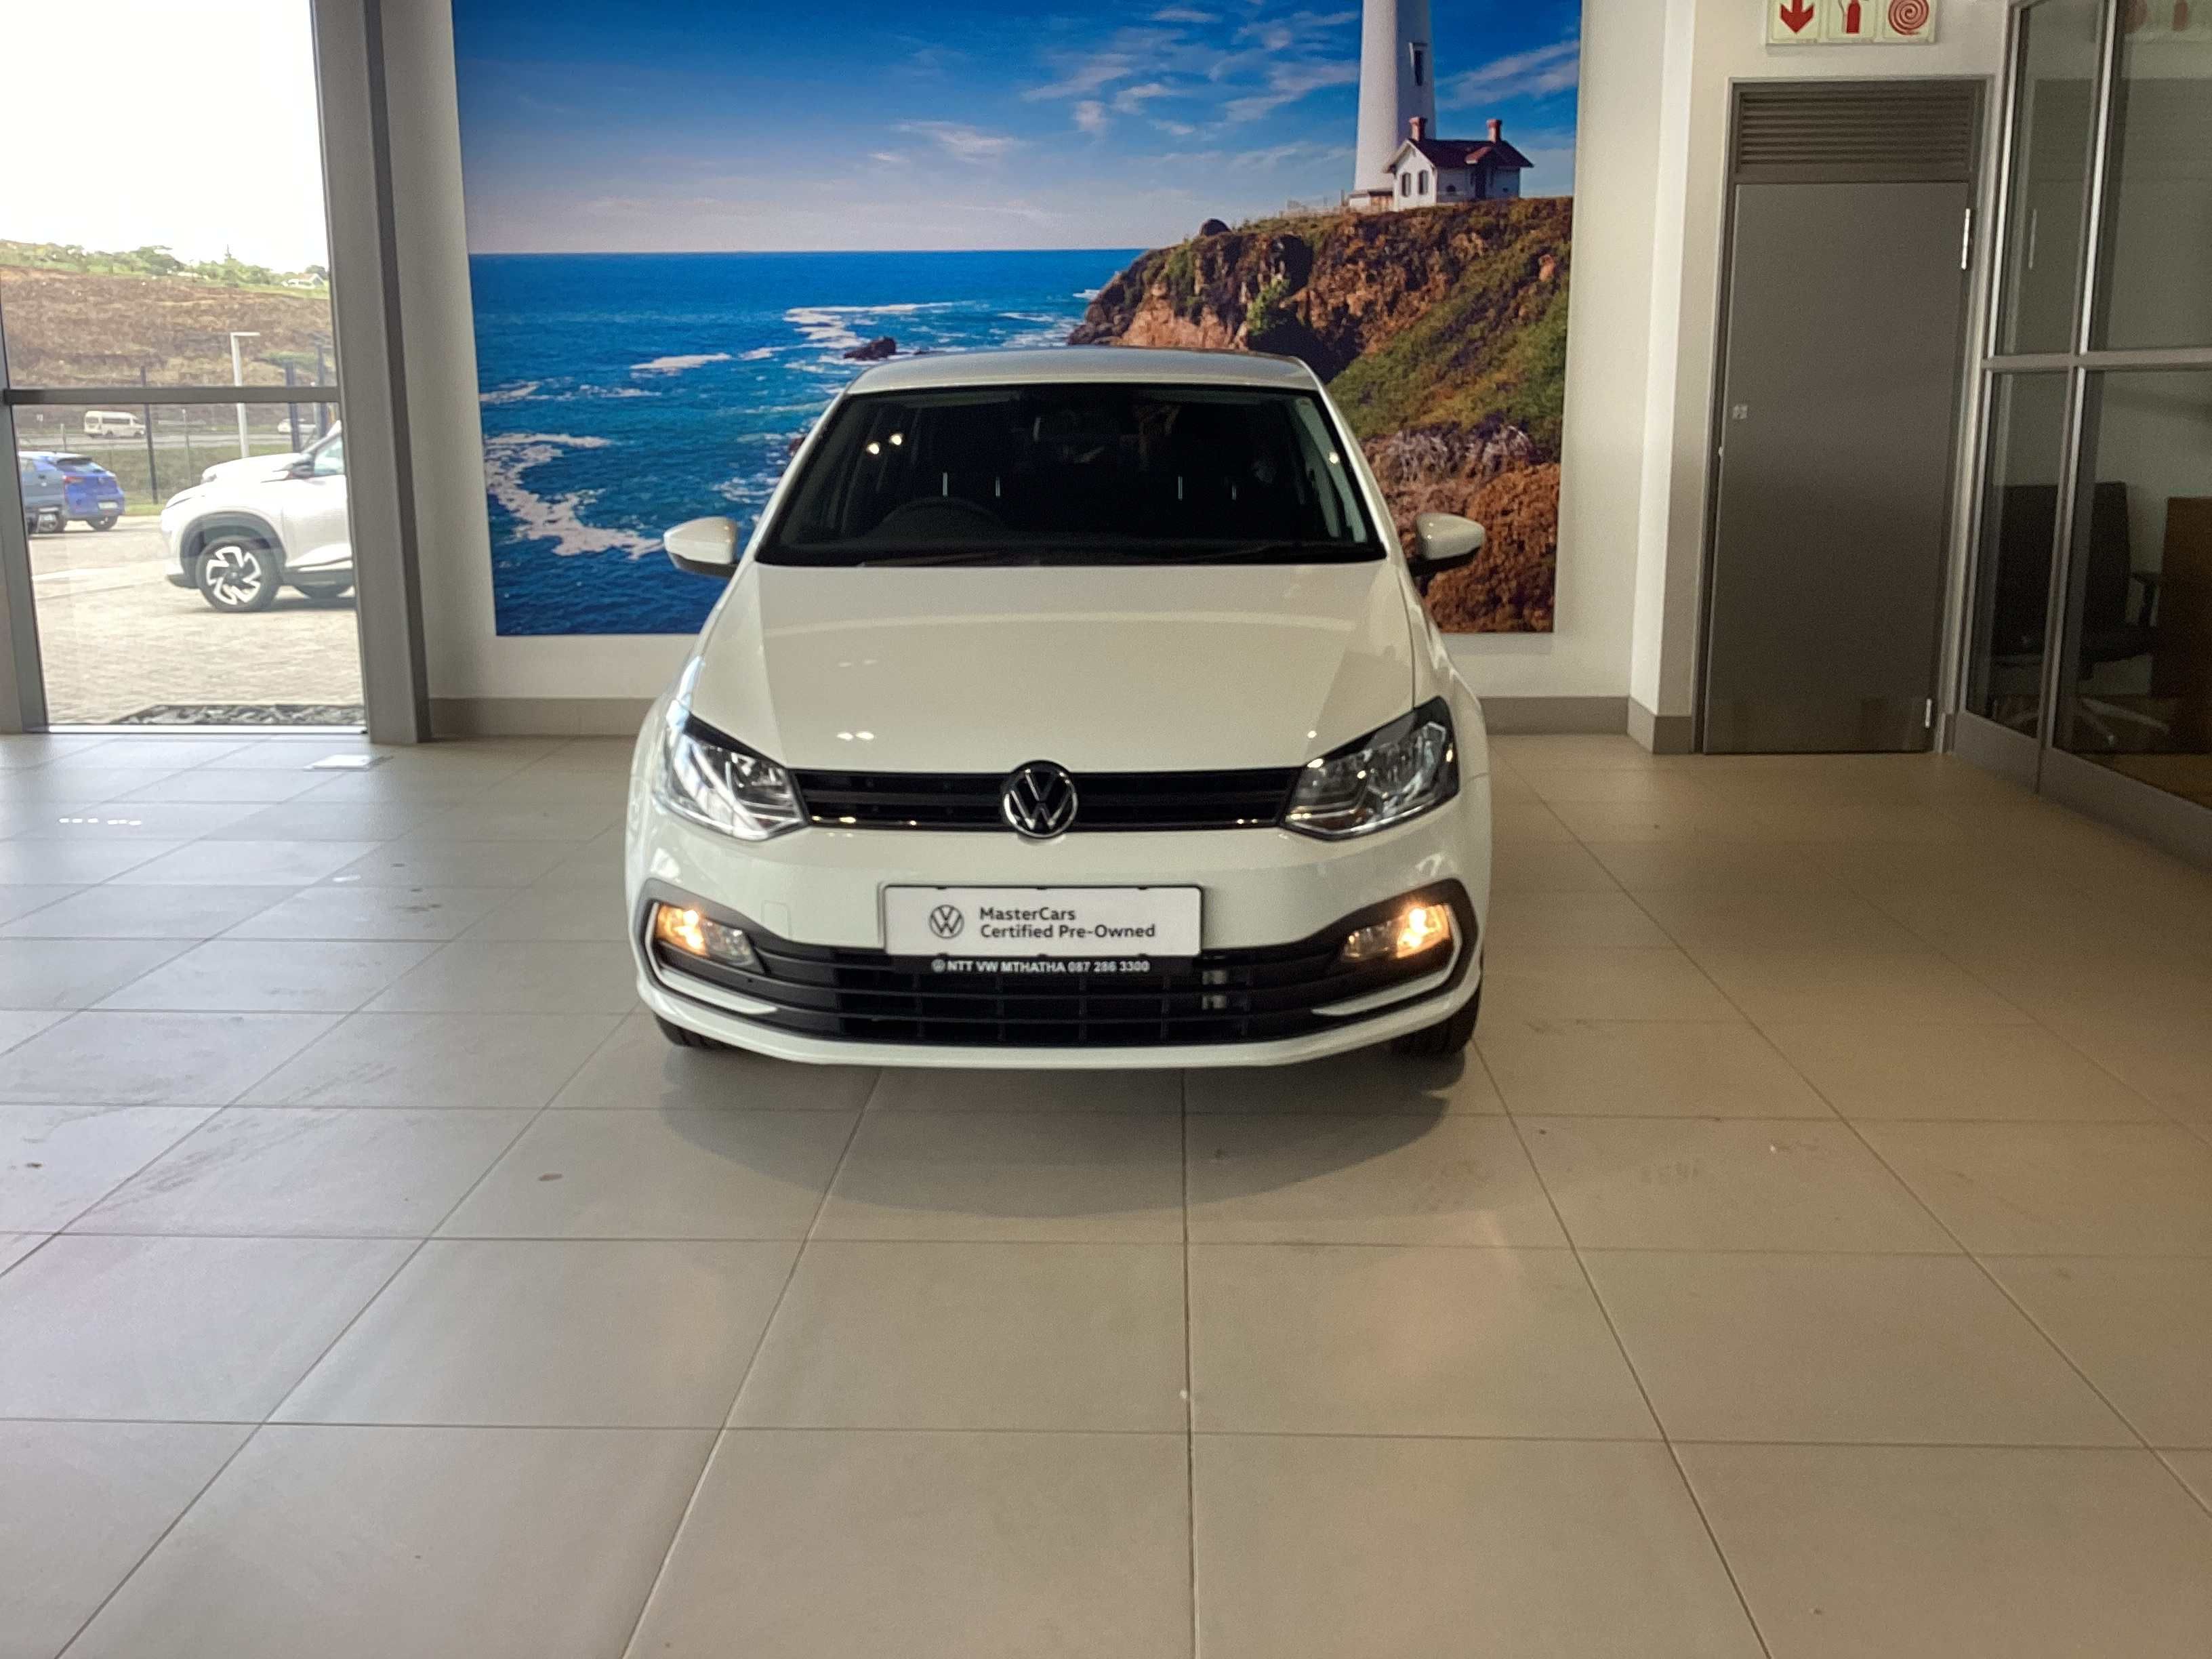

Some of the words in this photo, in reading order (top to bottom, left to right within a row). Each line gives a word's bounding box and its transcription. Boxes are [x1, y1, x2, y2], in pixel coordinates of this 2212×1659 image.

[980, 907, 1076, 920] MasterCars
[981, 924, 1053, 938] Certified
[1059, 924, 1155, 938] Pre-Owned
[947, 960, 972, 972] NTT
[976, 960, 998, 972] VW
[1000, 961, 1066, 972] MTHATHA
